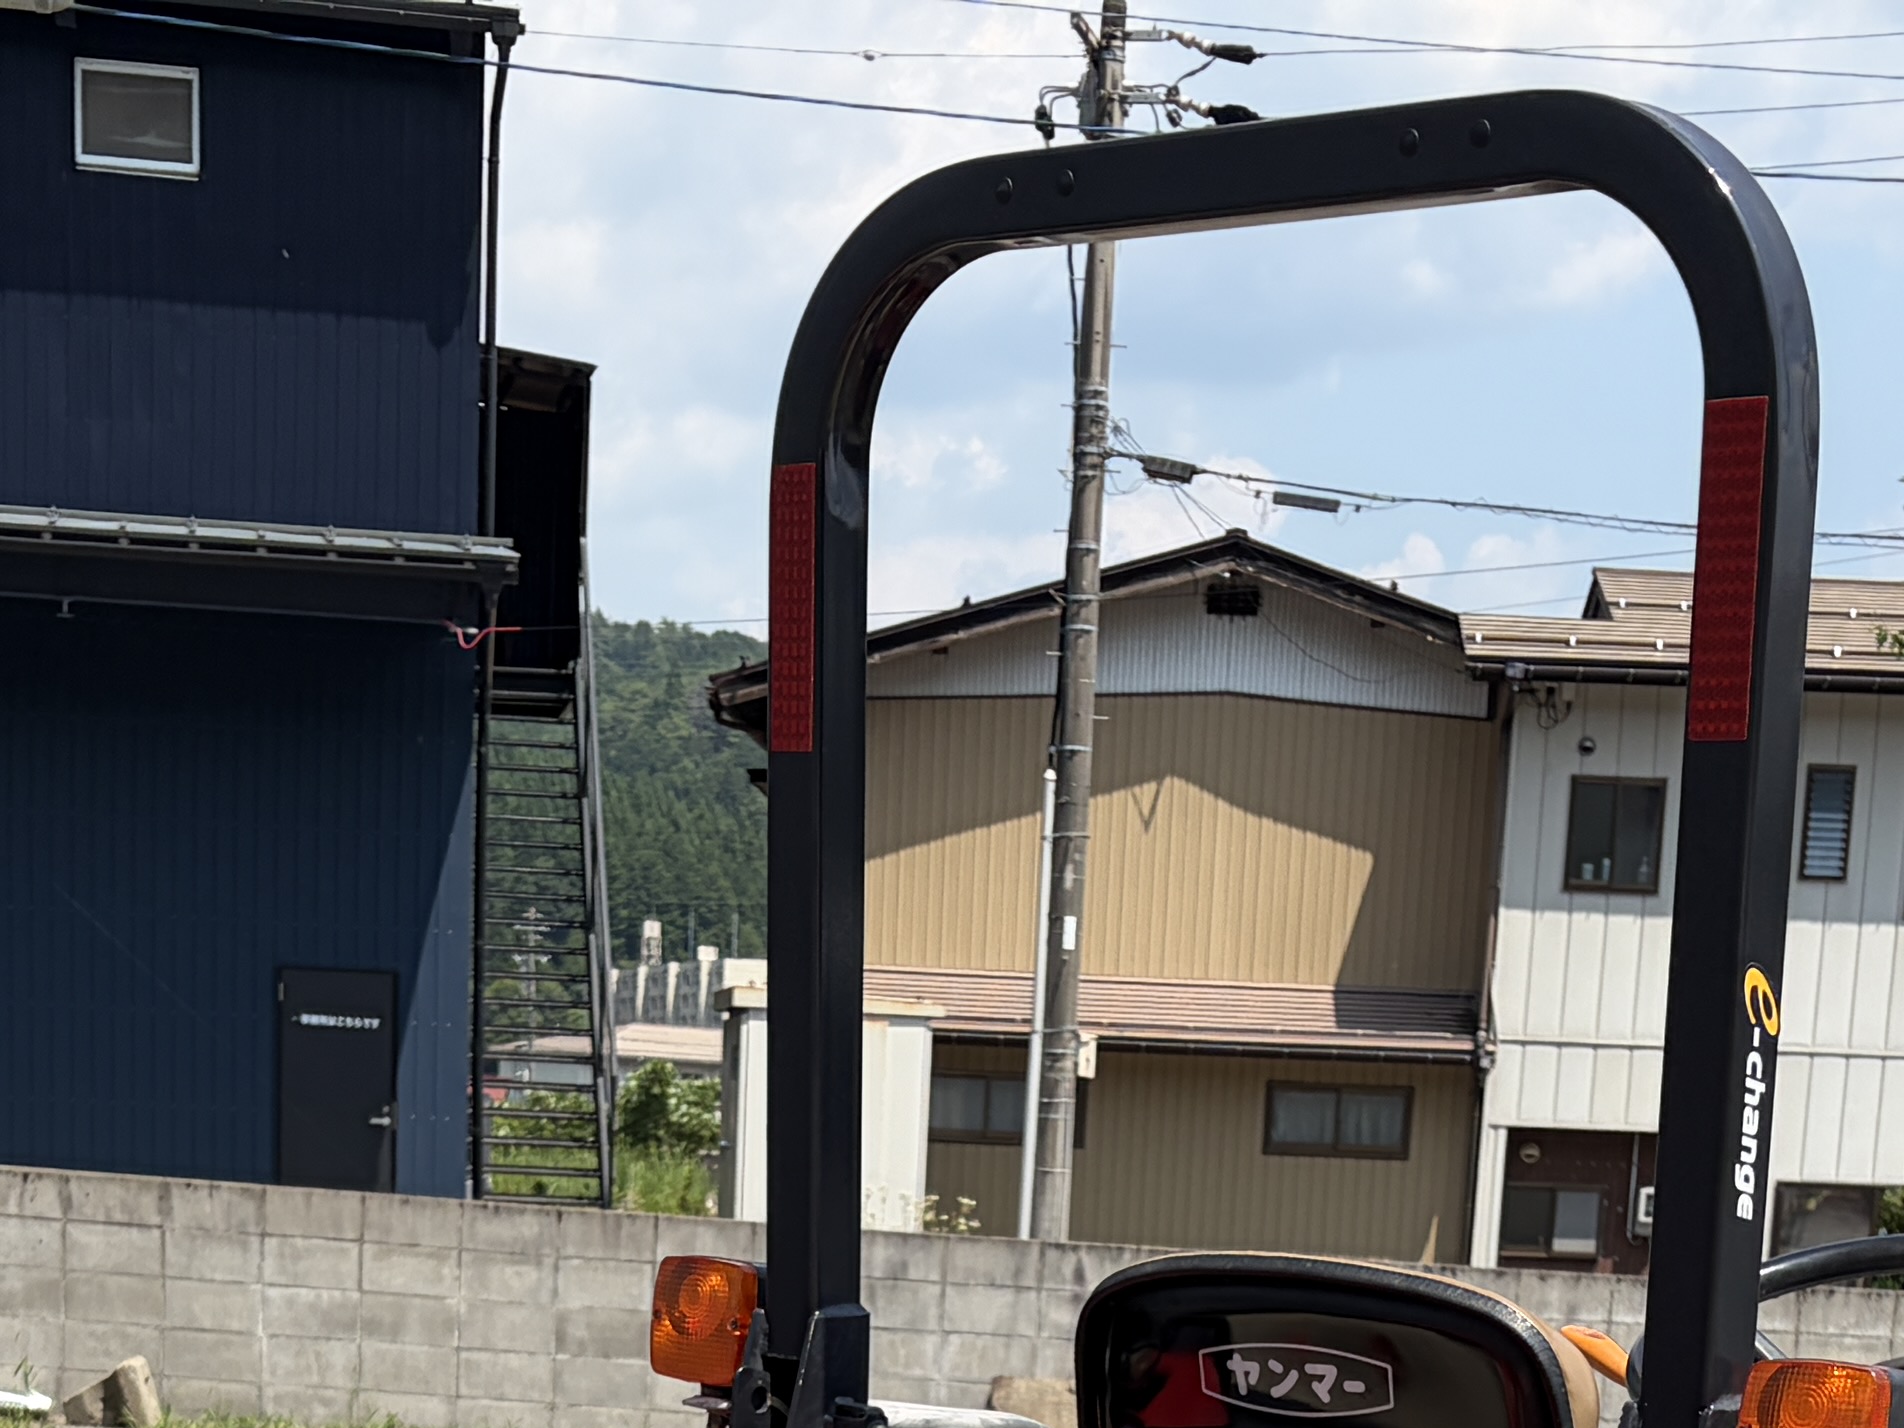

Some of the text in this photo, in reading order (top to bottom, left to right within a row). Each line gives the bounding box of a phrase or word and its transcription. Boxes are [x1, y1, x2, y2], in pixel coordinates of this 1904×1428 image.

[1734, 966, 1781, 1221] e-change
[1225, 1351, 1366, 1404] ヤンマー
